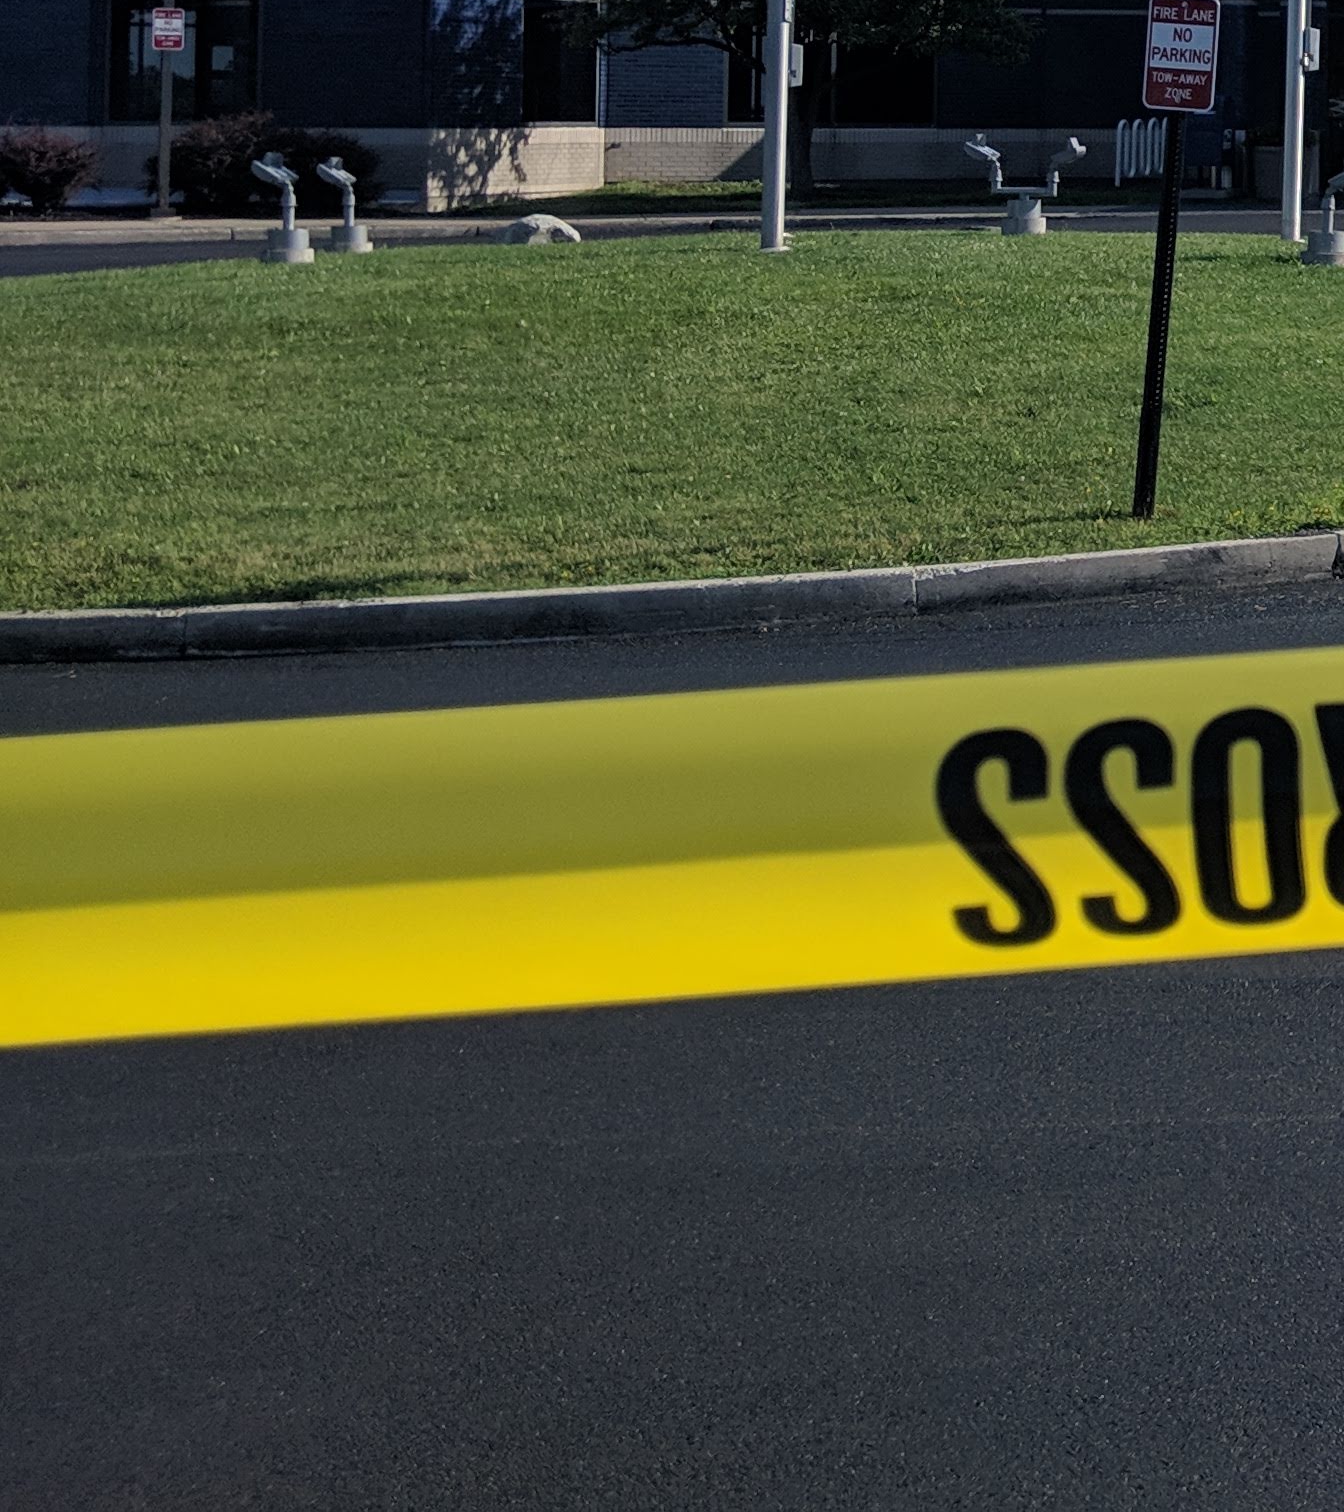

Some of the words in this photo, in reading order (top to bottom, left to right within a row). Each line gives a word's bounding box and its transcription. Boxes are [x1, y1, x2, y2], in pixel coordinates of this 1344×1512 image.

[1153, 6, 1178, 20] FIRE
[1183, 7, 1215, 22] LANE
[1173, 27, 1193, 43] NO
[1151, 46, 1211, 65] PARKING
[1152, 72, 1208, 86] TOW-AWAY
[1165, 87, 1193, 100] ZONE
